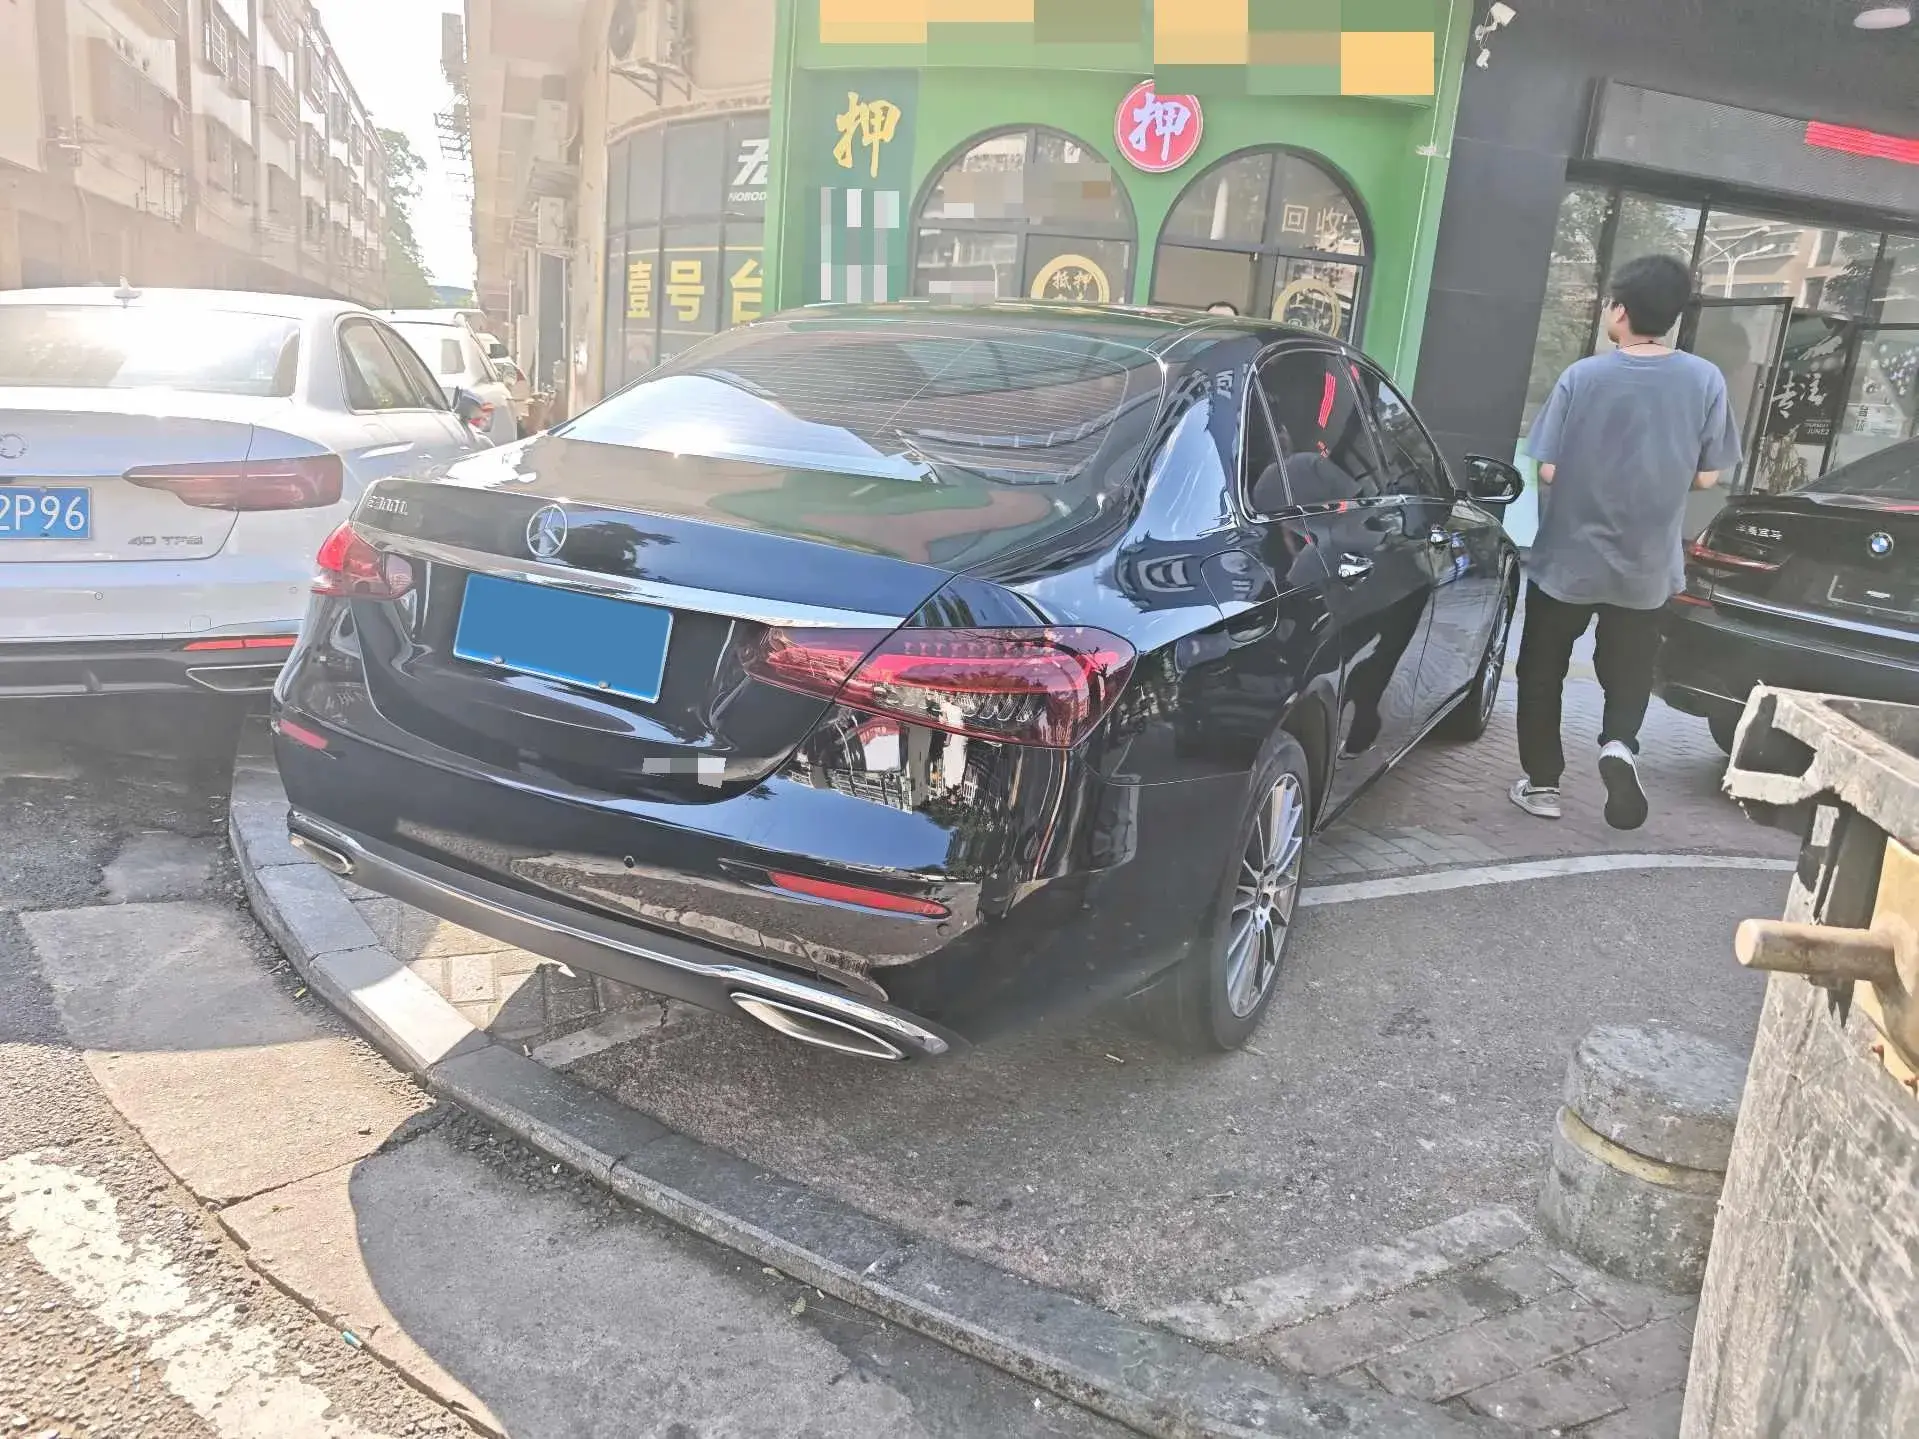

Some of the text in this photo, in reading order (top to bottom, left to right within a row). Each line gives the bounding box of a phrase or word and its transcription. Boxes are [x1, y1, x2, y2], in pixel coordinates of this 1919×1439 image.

[833, 91, 902, 179] 押
[1128, 92, 1191, 161] 押
[1052, 270, 1093, 292] 抵押
[127, 535, 157, 545] 40
